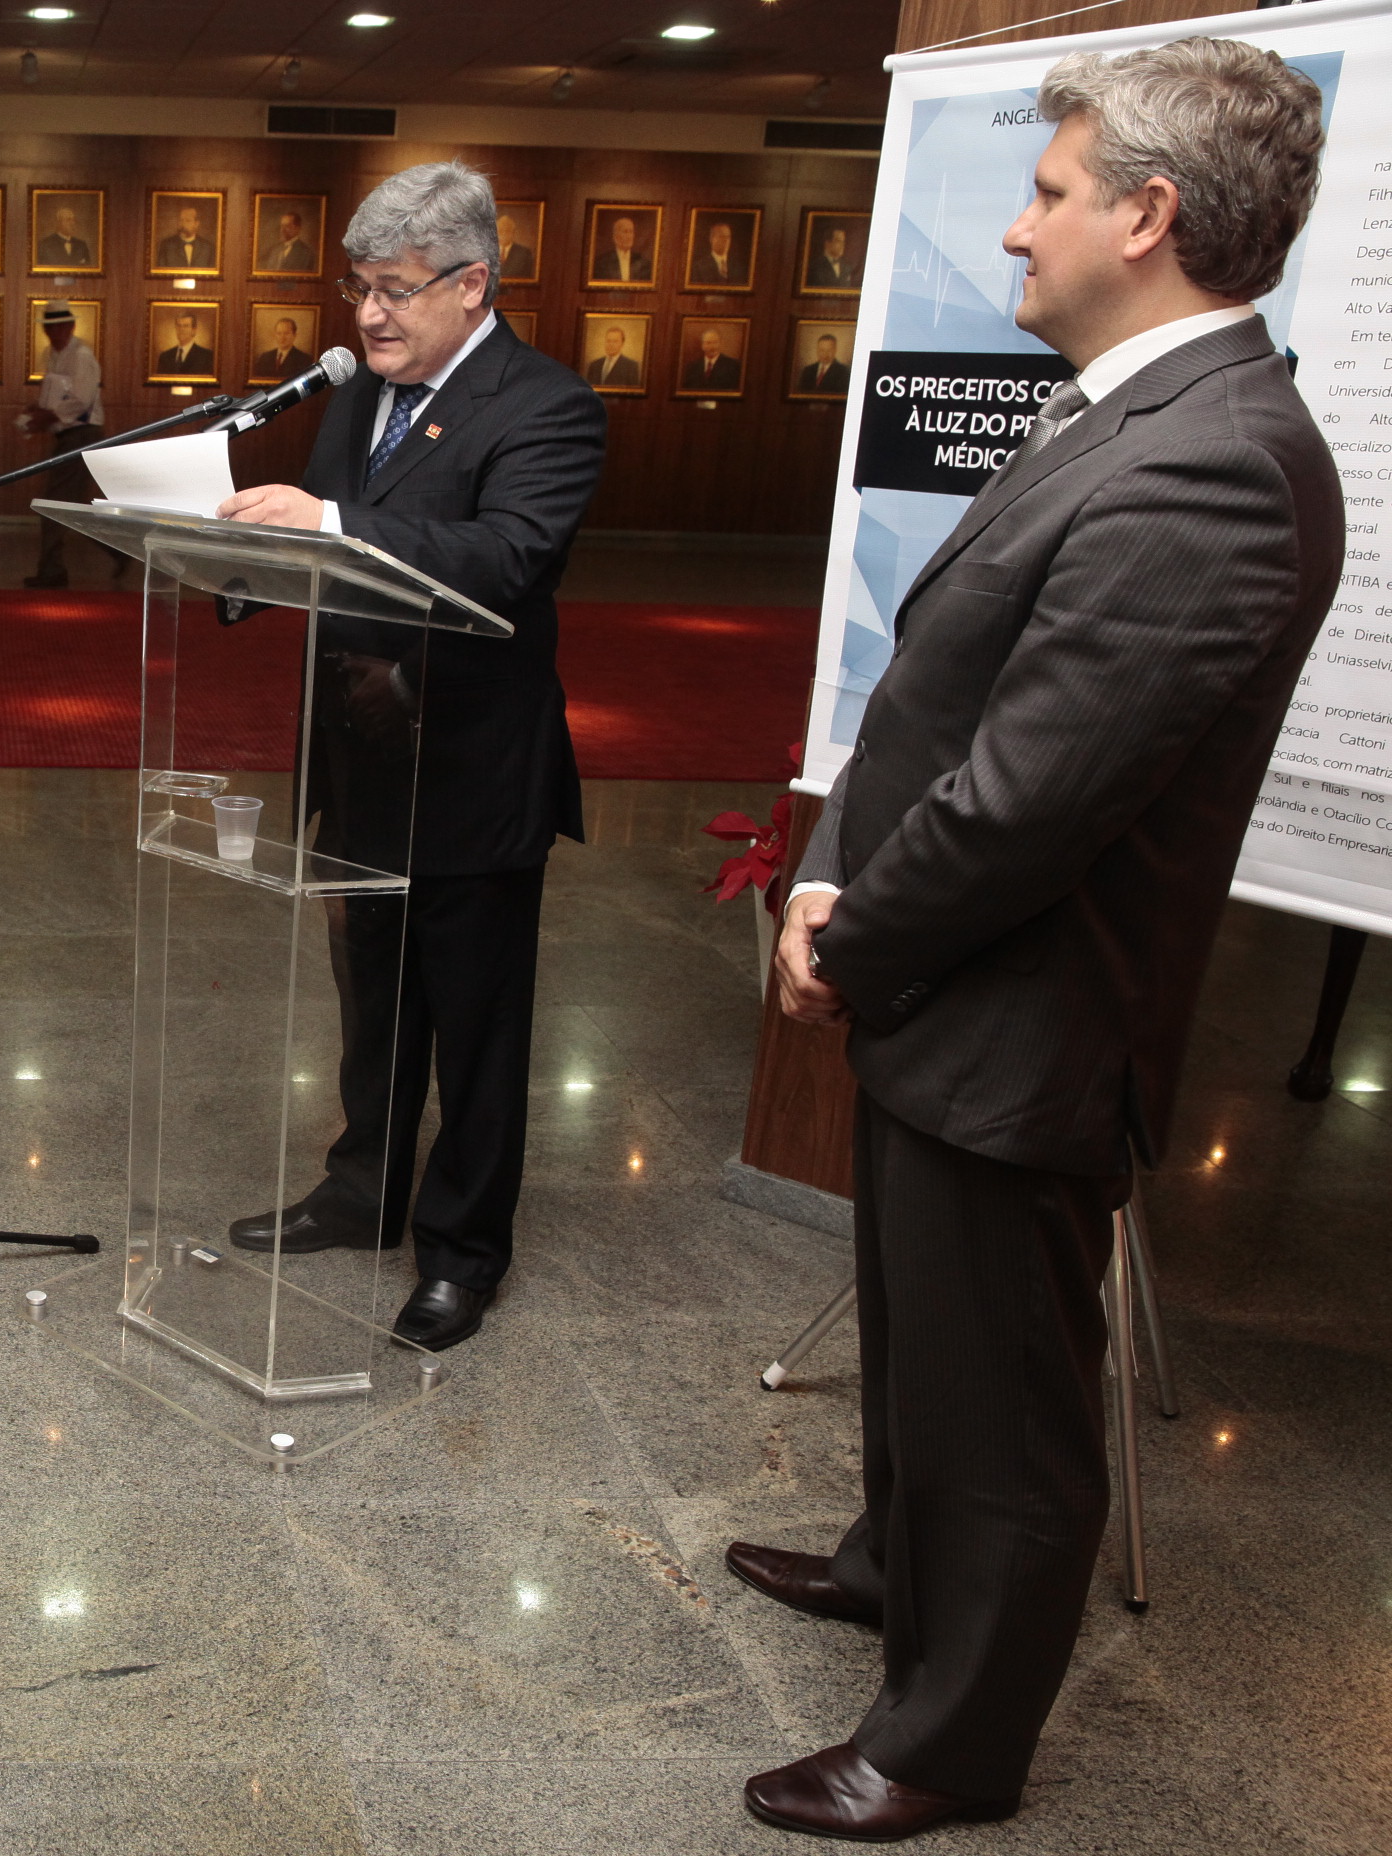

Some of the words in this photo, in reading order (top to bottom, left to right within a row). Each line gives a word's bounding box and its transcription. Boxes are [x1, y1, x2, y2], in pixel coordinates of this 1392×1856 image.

[1344, 302, 1372, 314] Alto
[1351, 330, 1373, 341] Em
[1334, 360, 1355, 369] em
[875, 375, 906, 398] OS
[909, 376, 1029, 404] PRECEITOS
[905, 405, 920, 431] À
[924, 410, 967, 434] LUZ
[969, 413, 1006, 436] DO
[1322, 412, 1340, 423] do
[1328, 627, 1344, 638] de
[1339, 733, 1386, 750] Cattoni
[1322, 759, 1352, 771] com
[1274, 773, 1291, 785] Sul
[1302, 780, 1310, 788] e
[1321, 781, 1350, 796] filiais
[1361, 791, 1385, 803] nos
[1311, 806, 1318, 815] e
[1323, 807, 1370, 826] Otacílio
[1267, 821, 1283, 833] do
[1286, 824, 1325, 842] Direito
